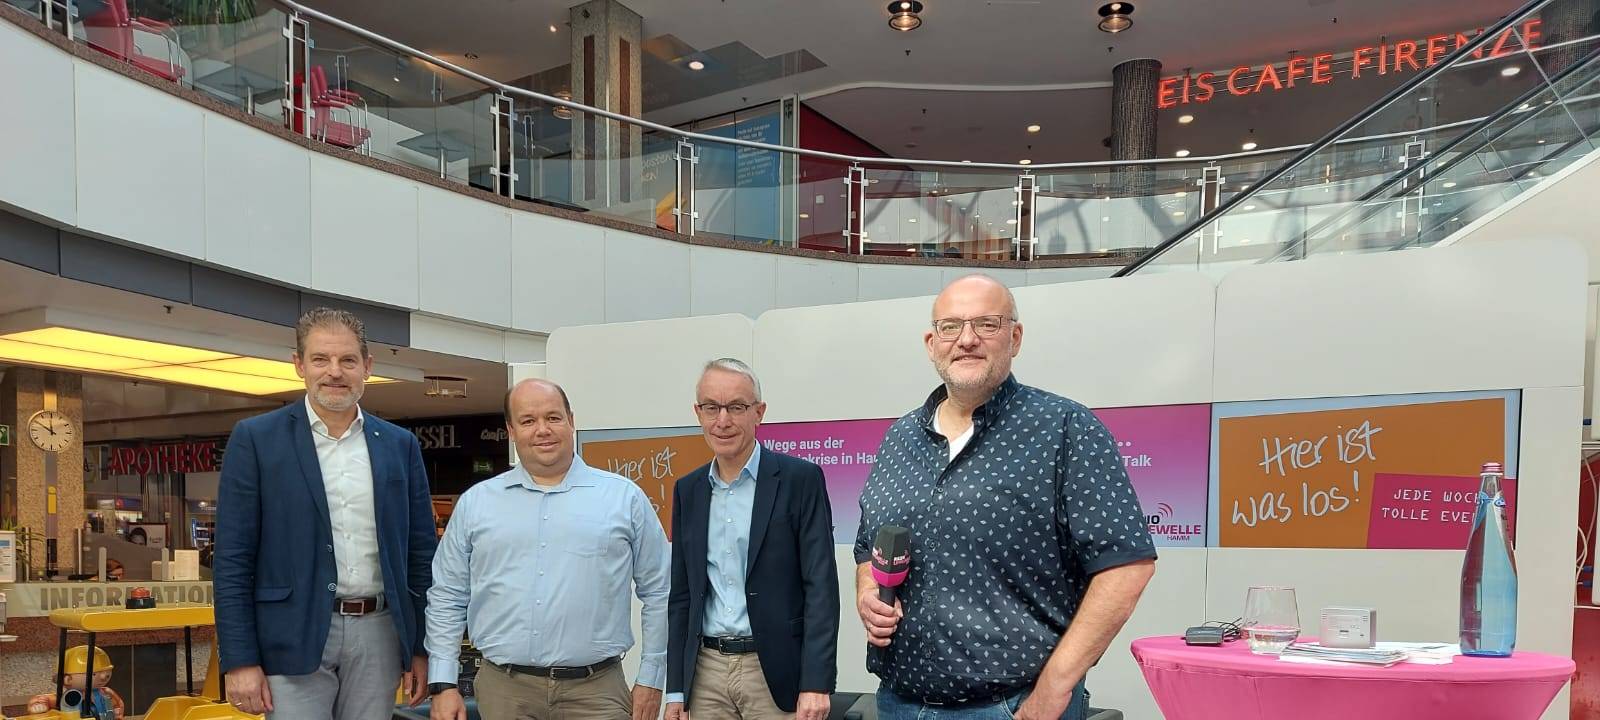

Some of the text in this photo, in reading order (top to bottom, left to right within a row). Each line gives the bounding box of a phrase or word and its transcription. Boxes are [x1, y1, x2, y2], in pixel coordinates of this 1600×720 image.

[1158, 72, 1215, 109] EIS
[1227, 52, 1334, 96] CAFE
[764, 437, 844, 453] Wege aus der
[1258, 420, 1383, 476] Hier ist
[109, 442, 217, 476] APOTHEKE
[650, 446, 677, 479] ist
[841, 453, 853, 464] in
[1122, 455, 1152, 467] Talk
[1231, 470, 1360, 527] was los!
[1393, 489, 1432, 501] JEDE
[1381, 507, 1475, 523] TOLLE EVE
